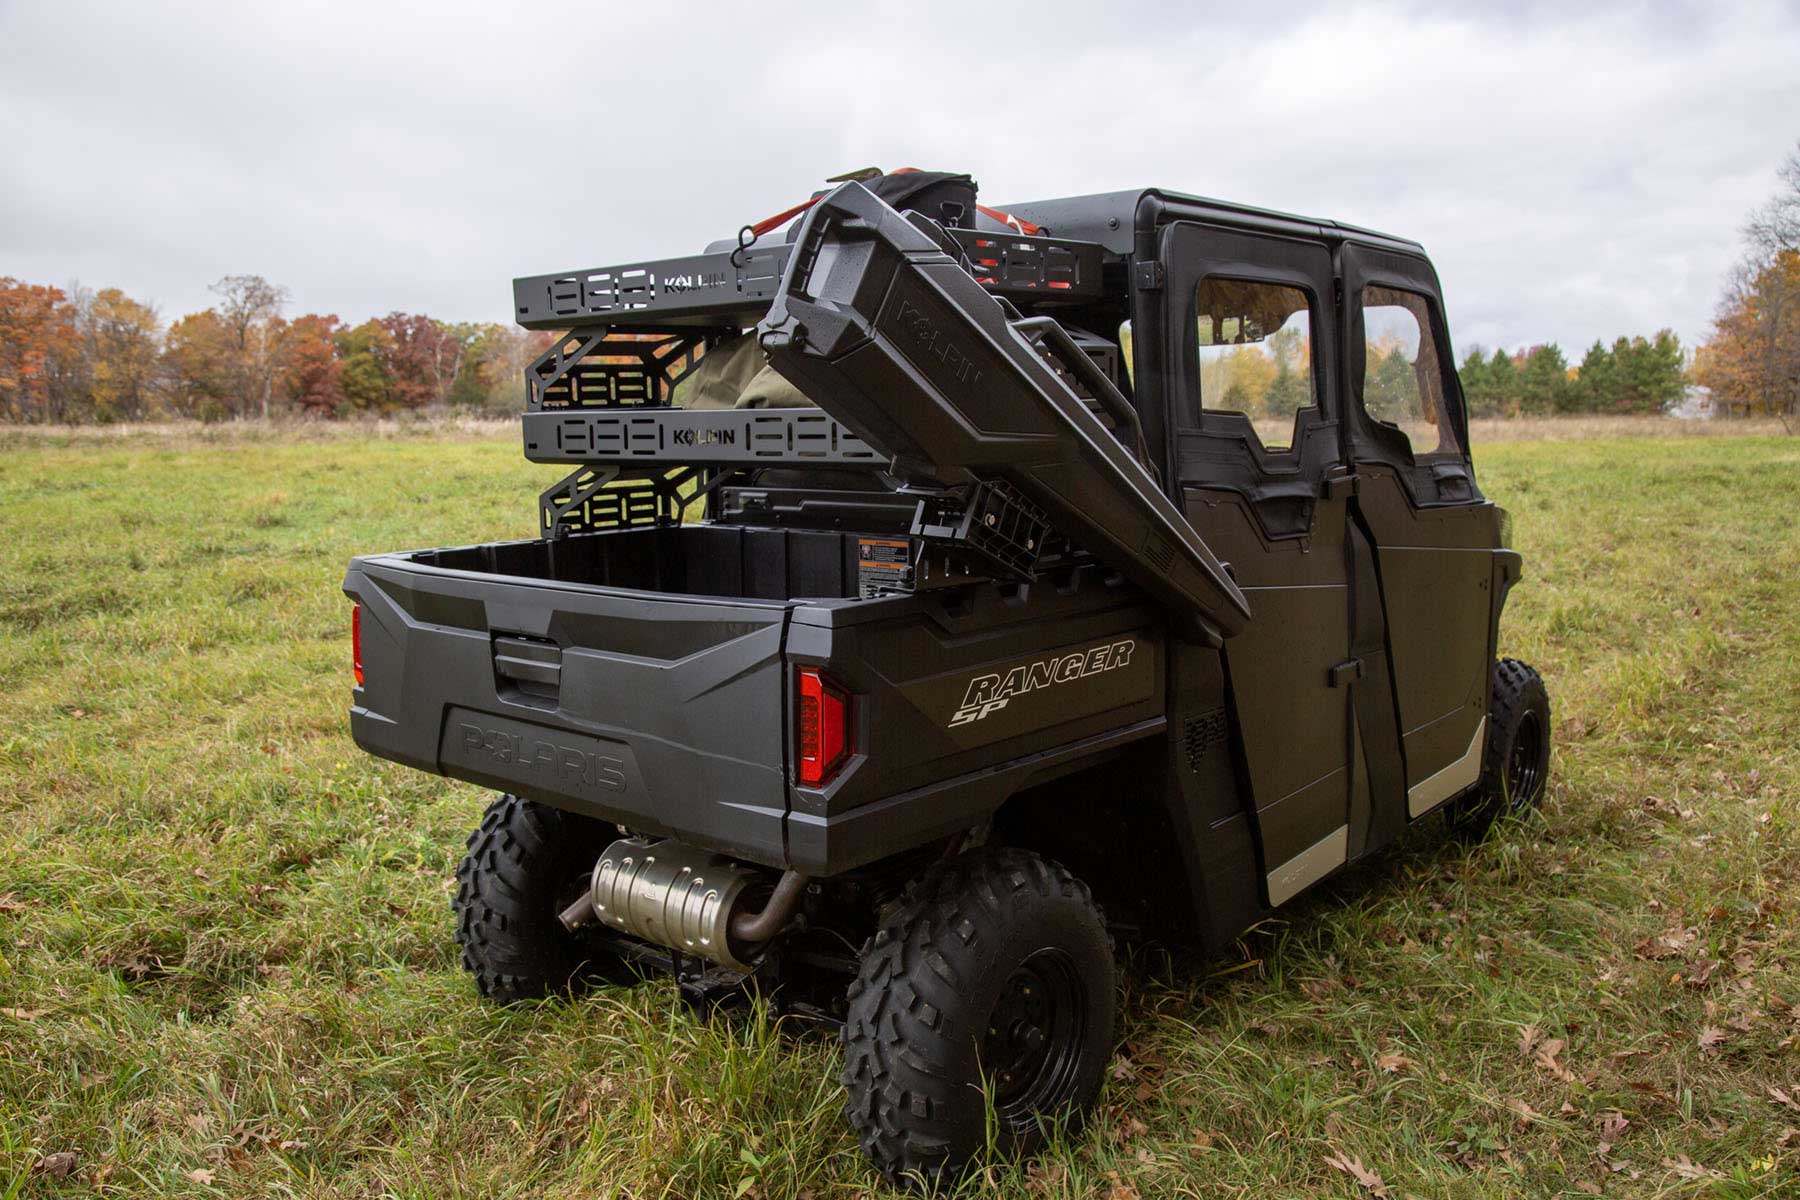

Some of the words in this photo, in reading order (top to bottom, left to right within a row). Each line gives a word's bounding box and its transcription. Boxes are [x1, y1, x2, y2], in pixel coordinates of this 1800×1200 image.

[672, 427, 736, 447] KOLPIN
[960, 639, 1136, 710] RANGER
[947, 698, 1010, 729] SP
[460, 722, 629, 795] POLARIS
